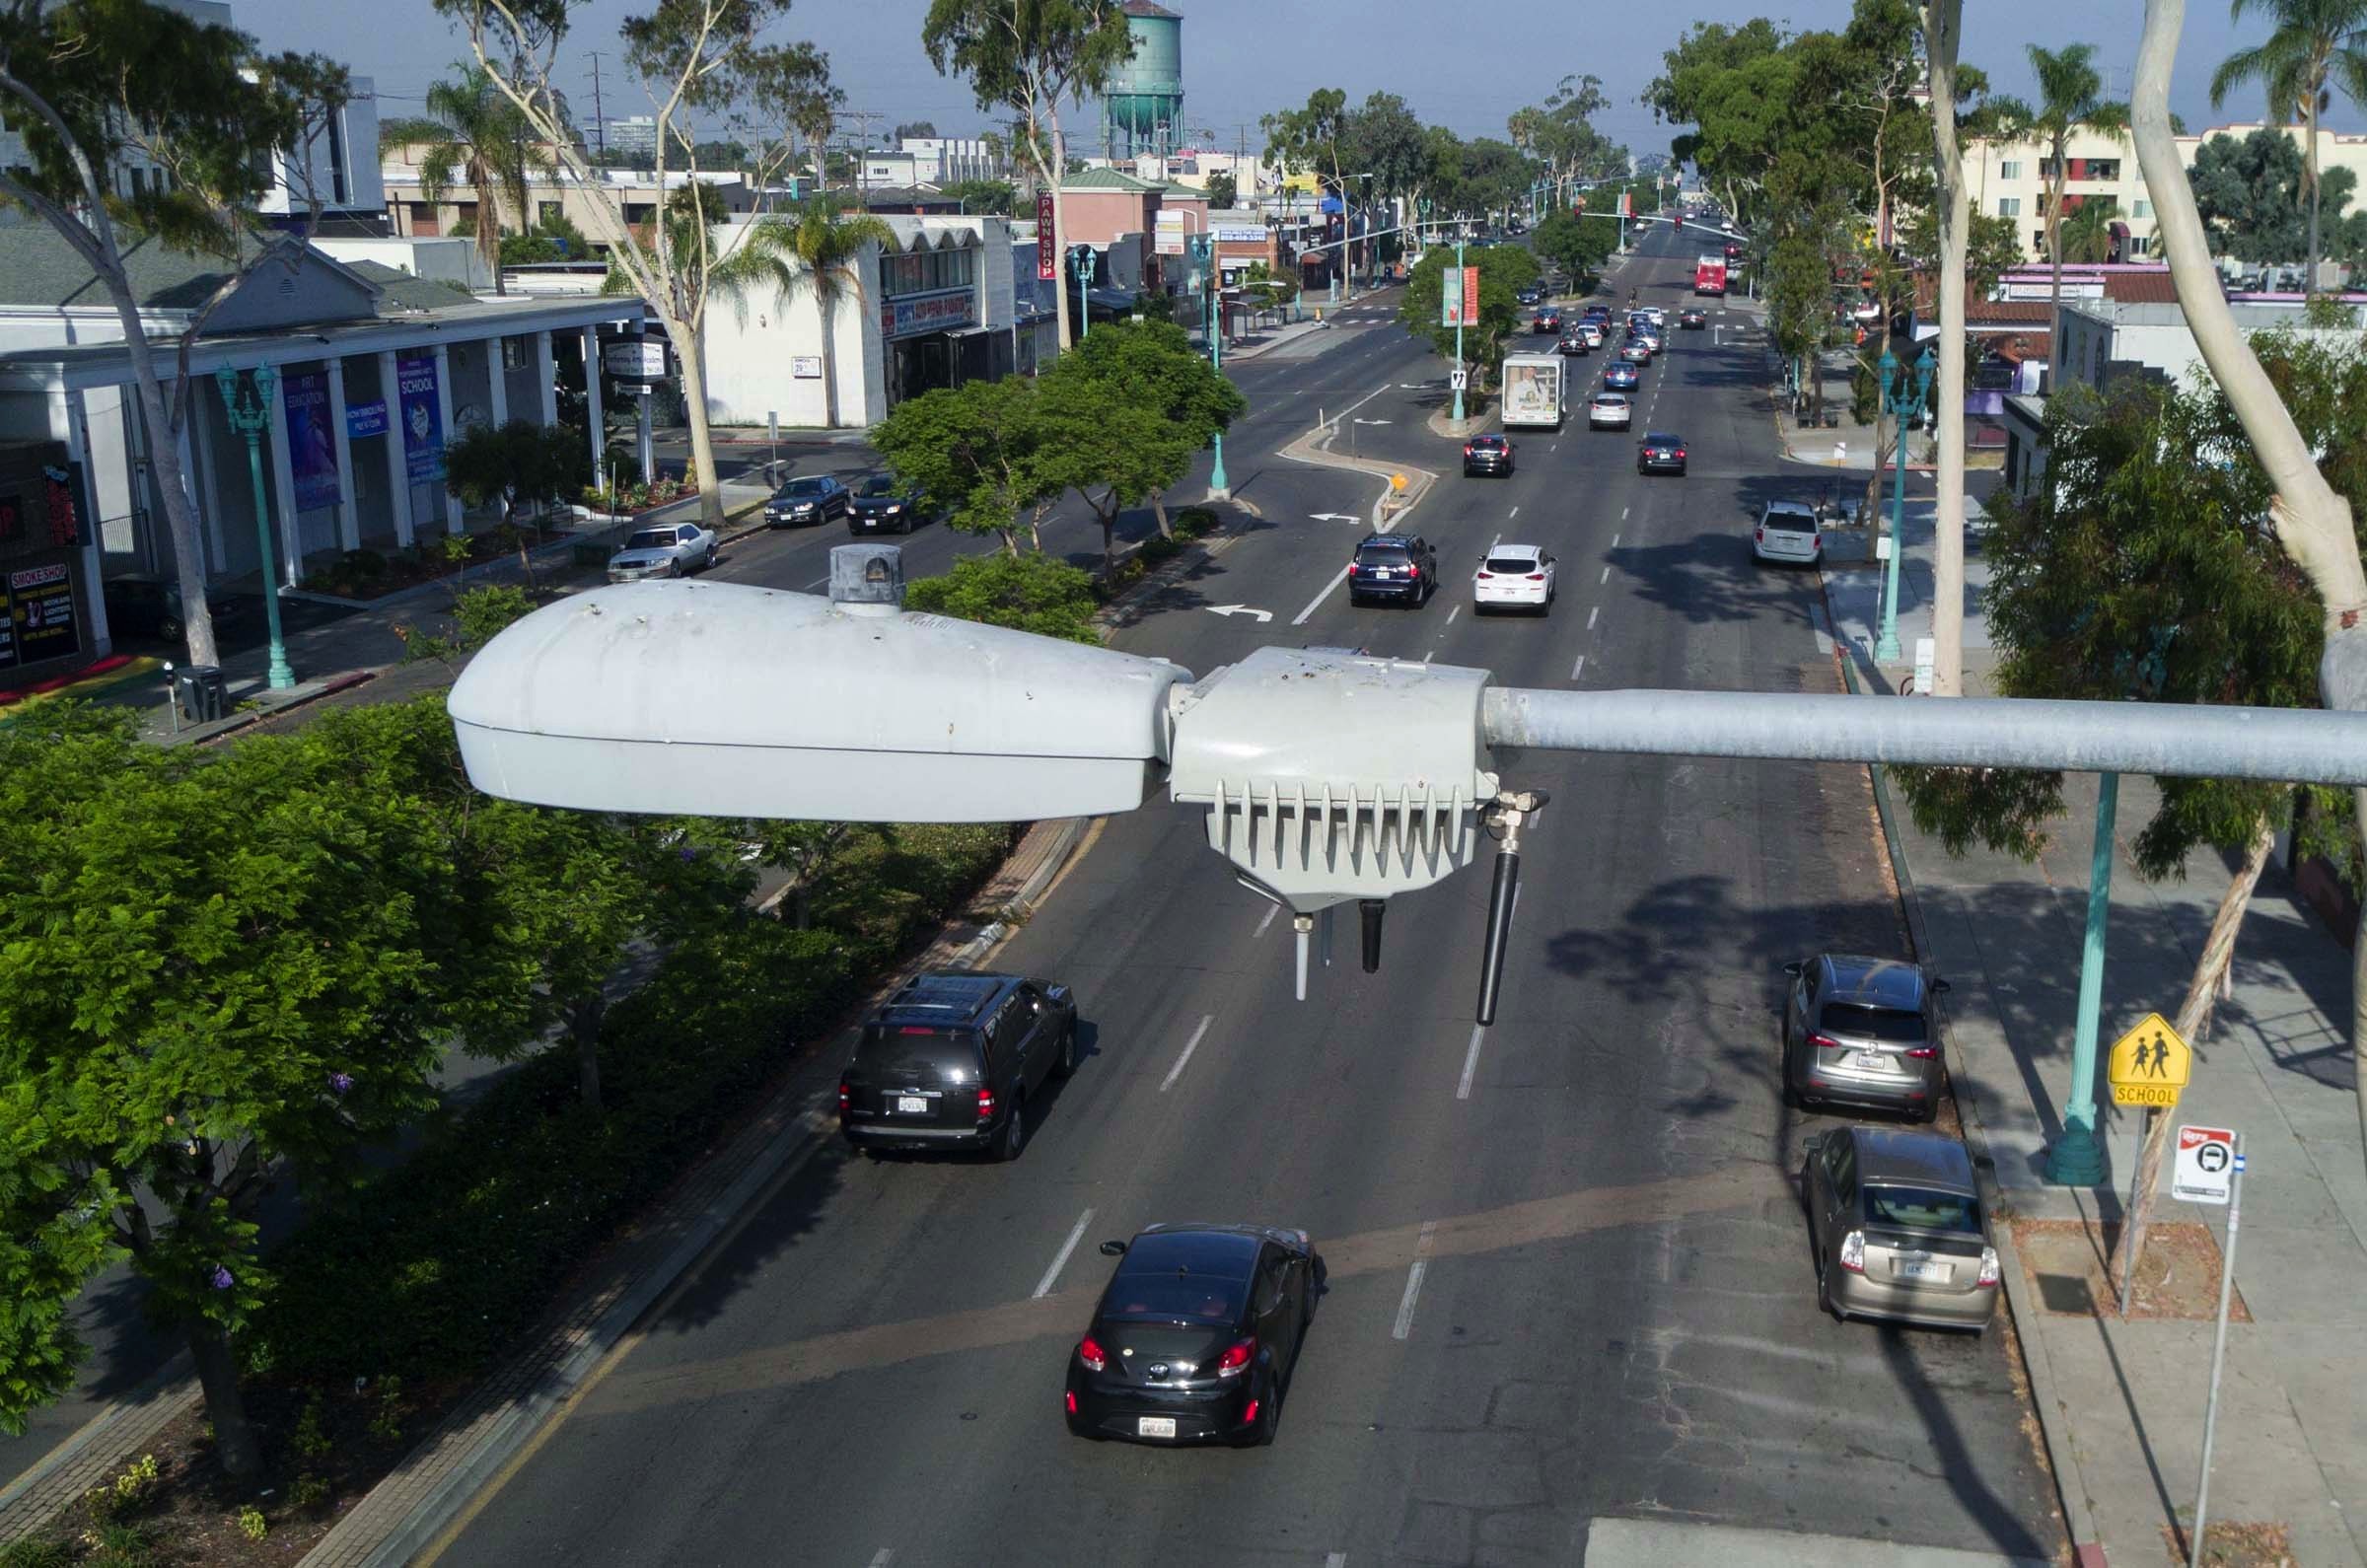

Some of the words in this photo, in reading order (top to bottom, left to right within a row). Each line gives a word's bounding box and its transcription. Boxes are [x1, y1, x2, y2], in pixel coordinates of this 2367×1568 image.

[1041, 199, 1051, 237] PAWN
[1042, 240, 1052, 277] SHOP
[401, 378, 434, 394] SCHOOL
[287, 392, 324, 408] EDUCATION
[13, 569, 42, 587] SMOKE
[43, 565, 65, 580] SHOP
[2117, 1088, 2175, 1104] SCHOOL
